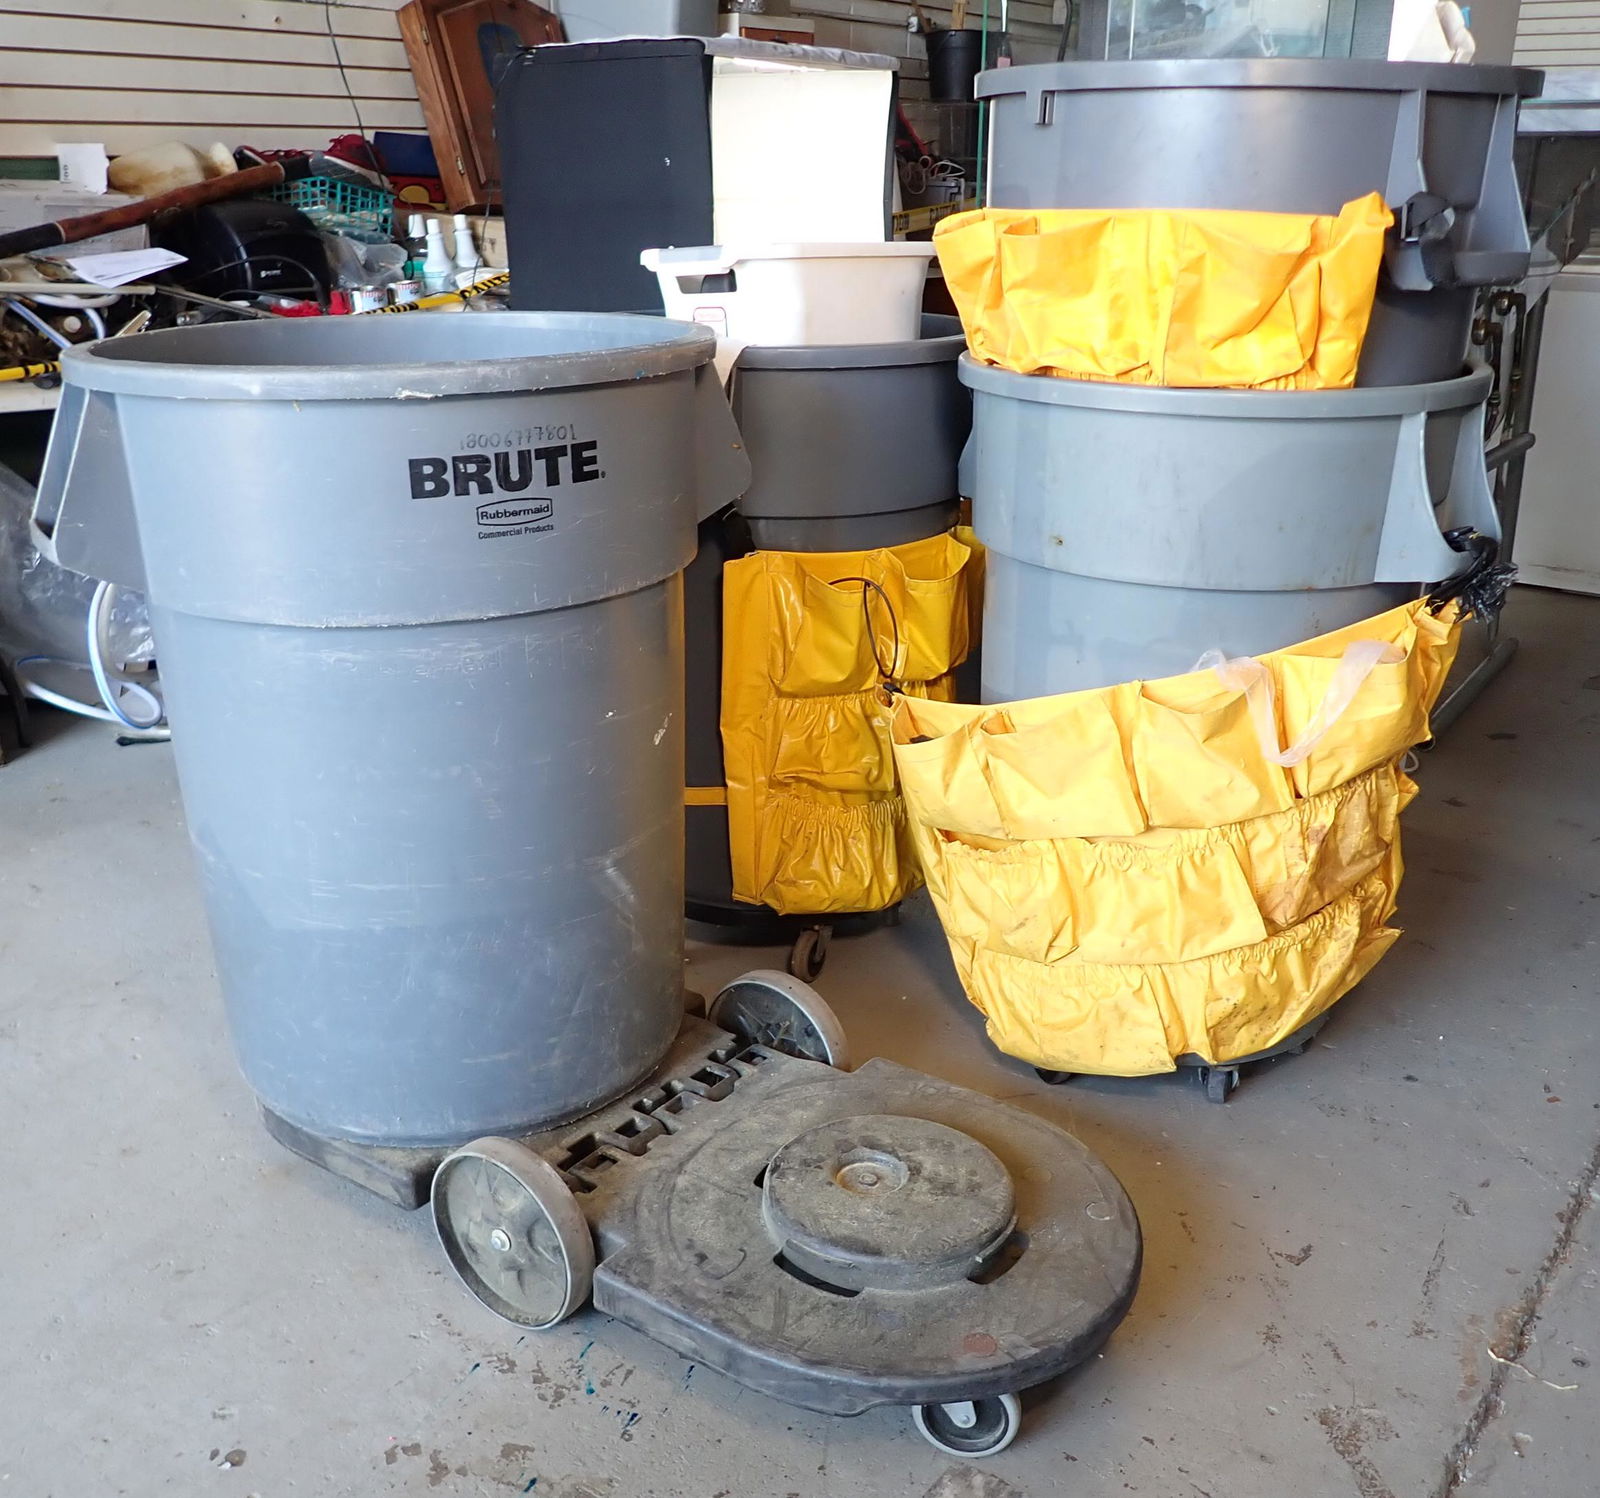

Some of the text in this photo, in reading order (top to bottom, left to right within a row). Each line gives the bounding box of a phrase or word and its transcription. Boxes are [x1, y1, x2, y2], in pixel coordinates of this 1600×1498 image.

[480, 504, 550, 521] Rubbermaid
[478, 523, 554, 540] Commercial Products
